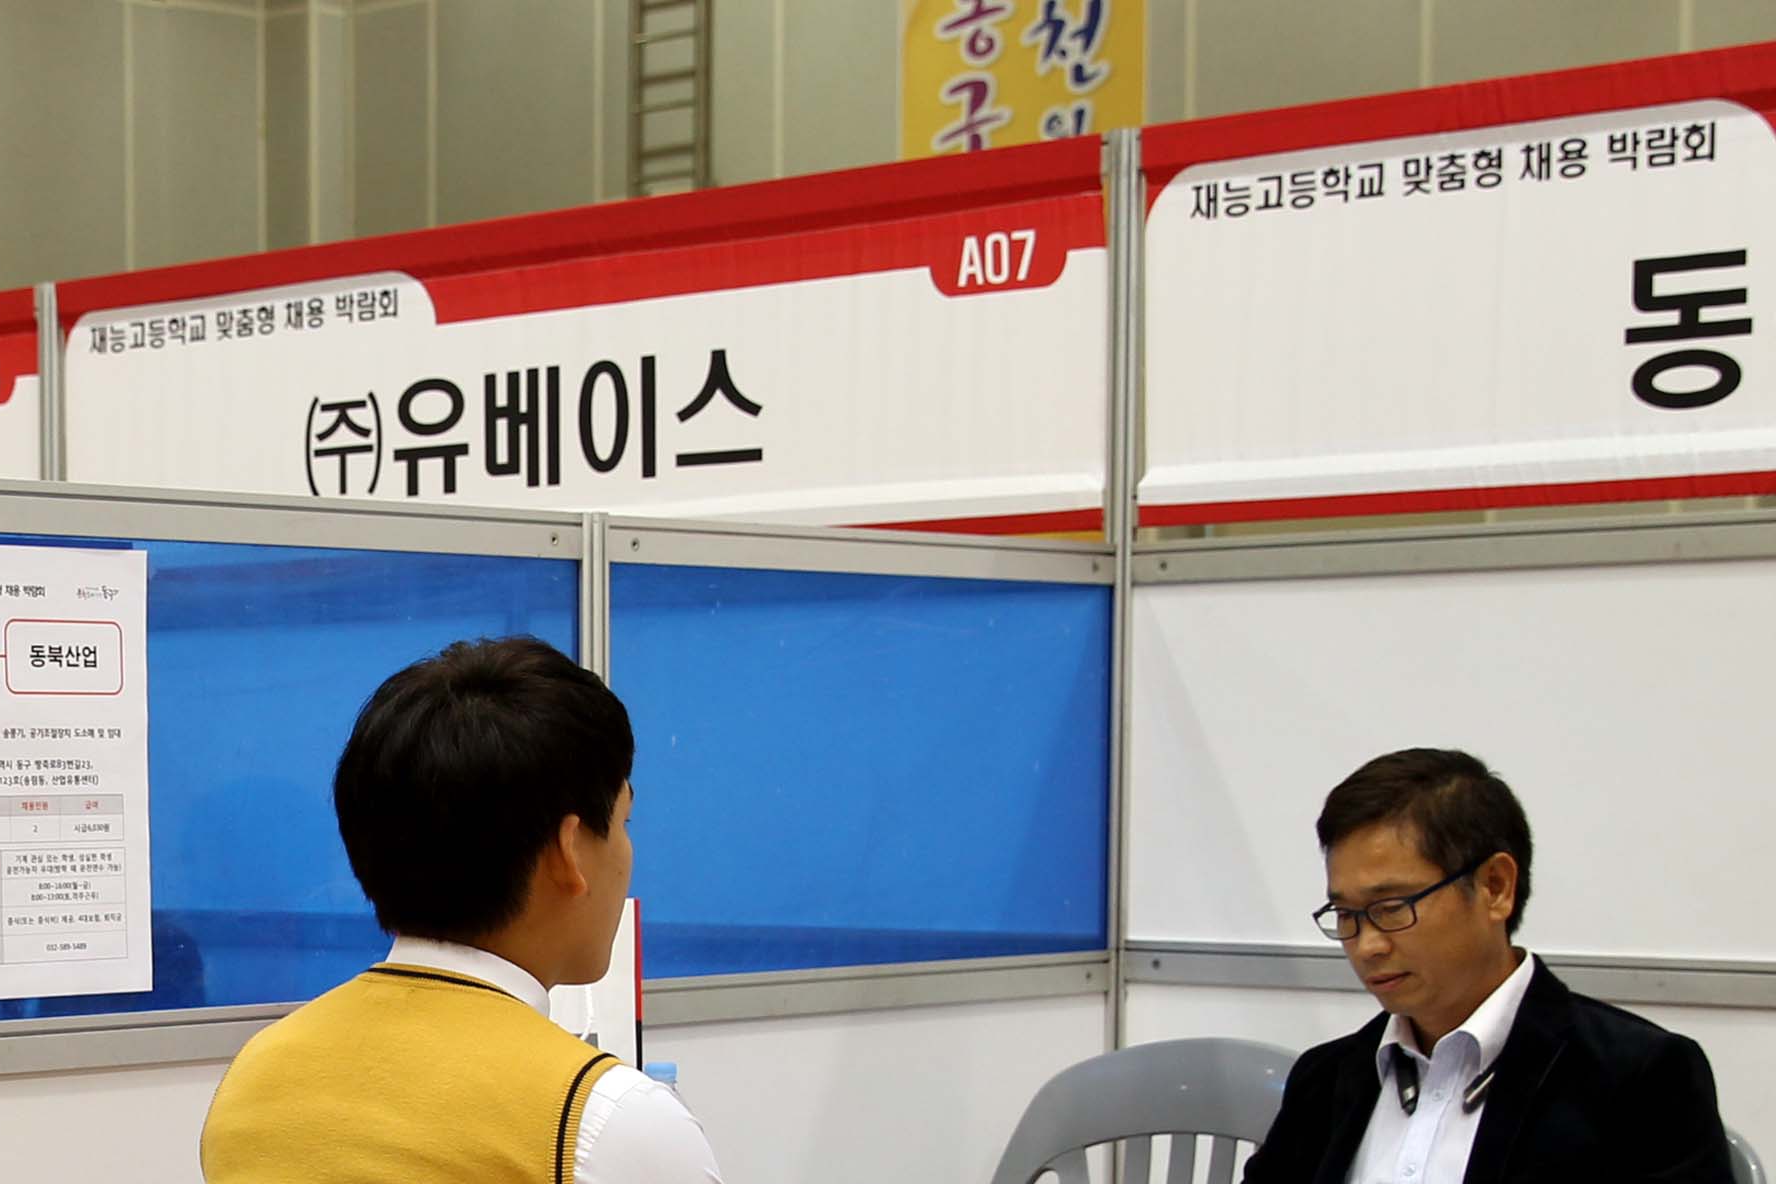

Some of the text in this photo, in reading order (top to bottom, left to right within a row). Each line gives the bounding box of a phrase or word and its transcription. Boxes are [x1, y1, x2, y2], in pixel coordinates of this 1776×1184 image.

[1189, 120, 1718, 221] 재능고등학교 맞춤형 채용 박람회
[957, 229, 1036, 288] A07
[89, 287, 399, 355] 재능고등학교 맞춤형 채용 박람회
[1623, 248, 1755, 411] 동
[29, 645, 97, 668] 동북산업
